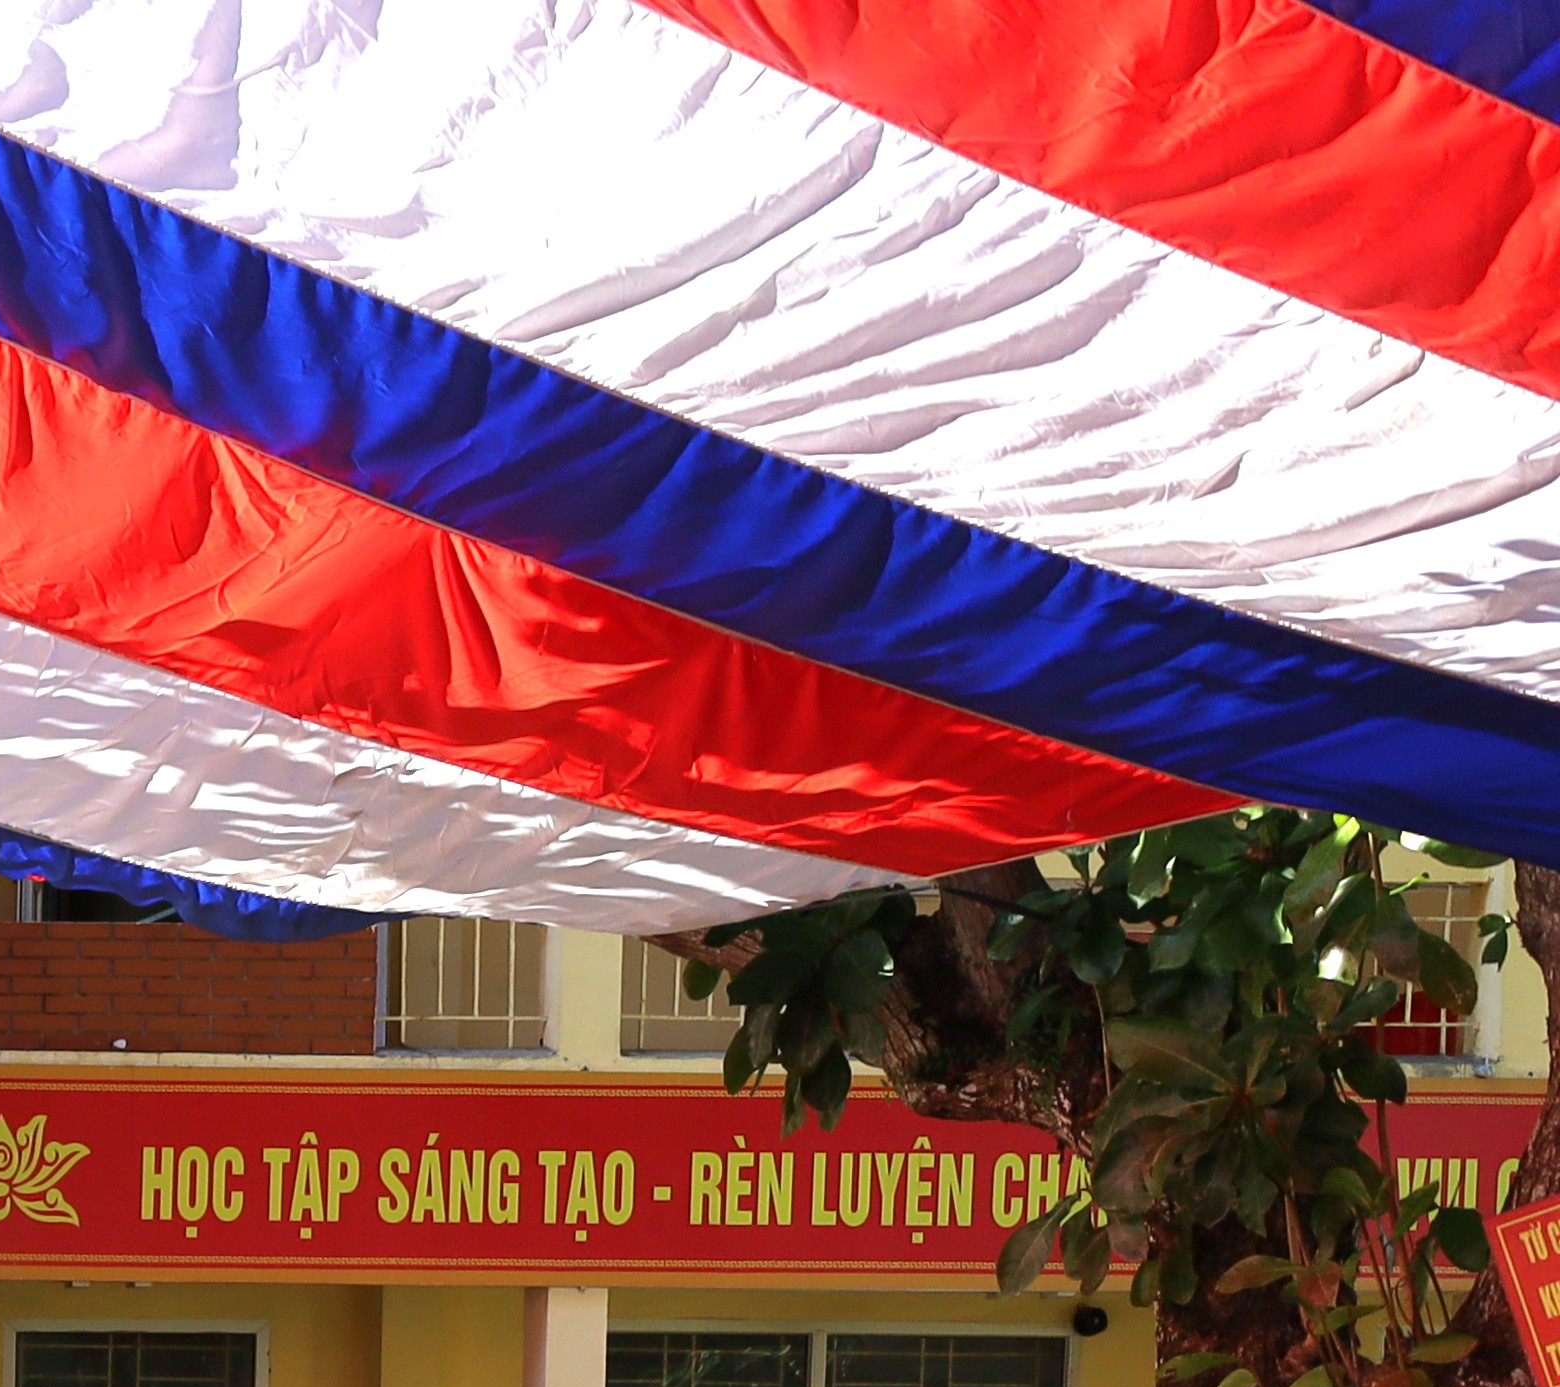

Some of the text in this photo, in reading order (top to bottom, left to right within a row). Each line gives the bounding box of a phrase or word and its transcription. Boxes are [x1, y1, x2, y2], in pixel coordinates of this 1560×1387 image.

[140, 1146, 246, 1239] HỌC
[263, 1132, 360, 1240] TẬP
[378, 1133, 520, 1224] SÁNG
[538, 1149, 635, 1242] TẠO
[689, 1135, 794, 1226] RÈN
[811, 1136, 974, 1244] LUYỆN
